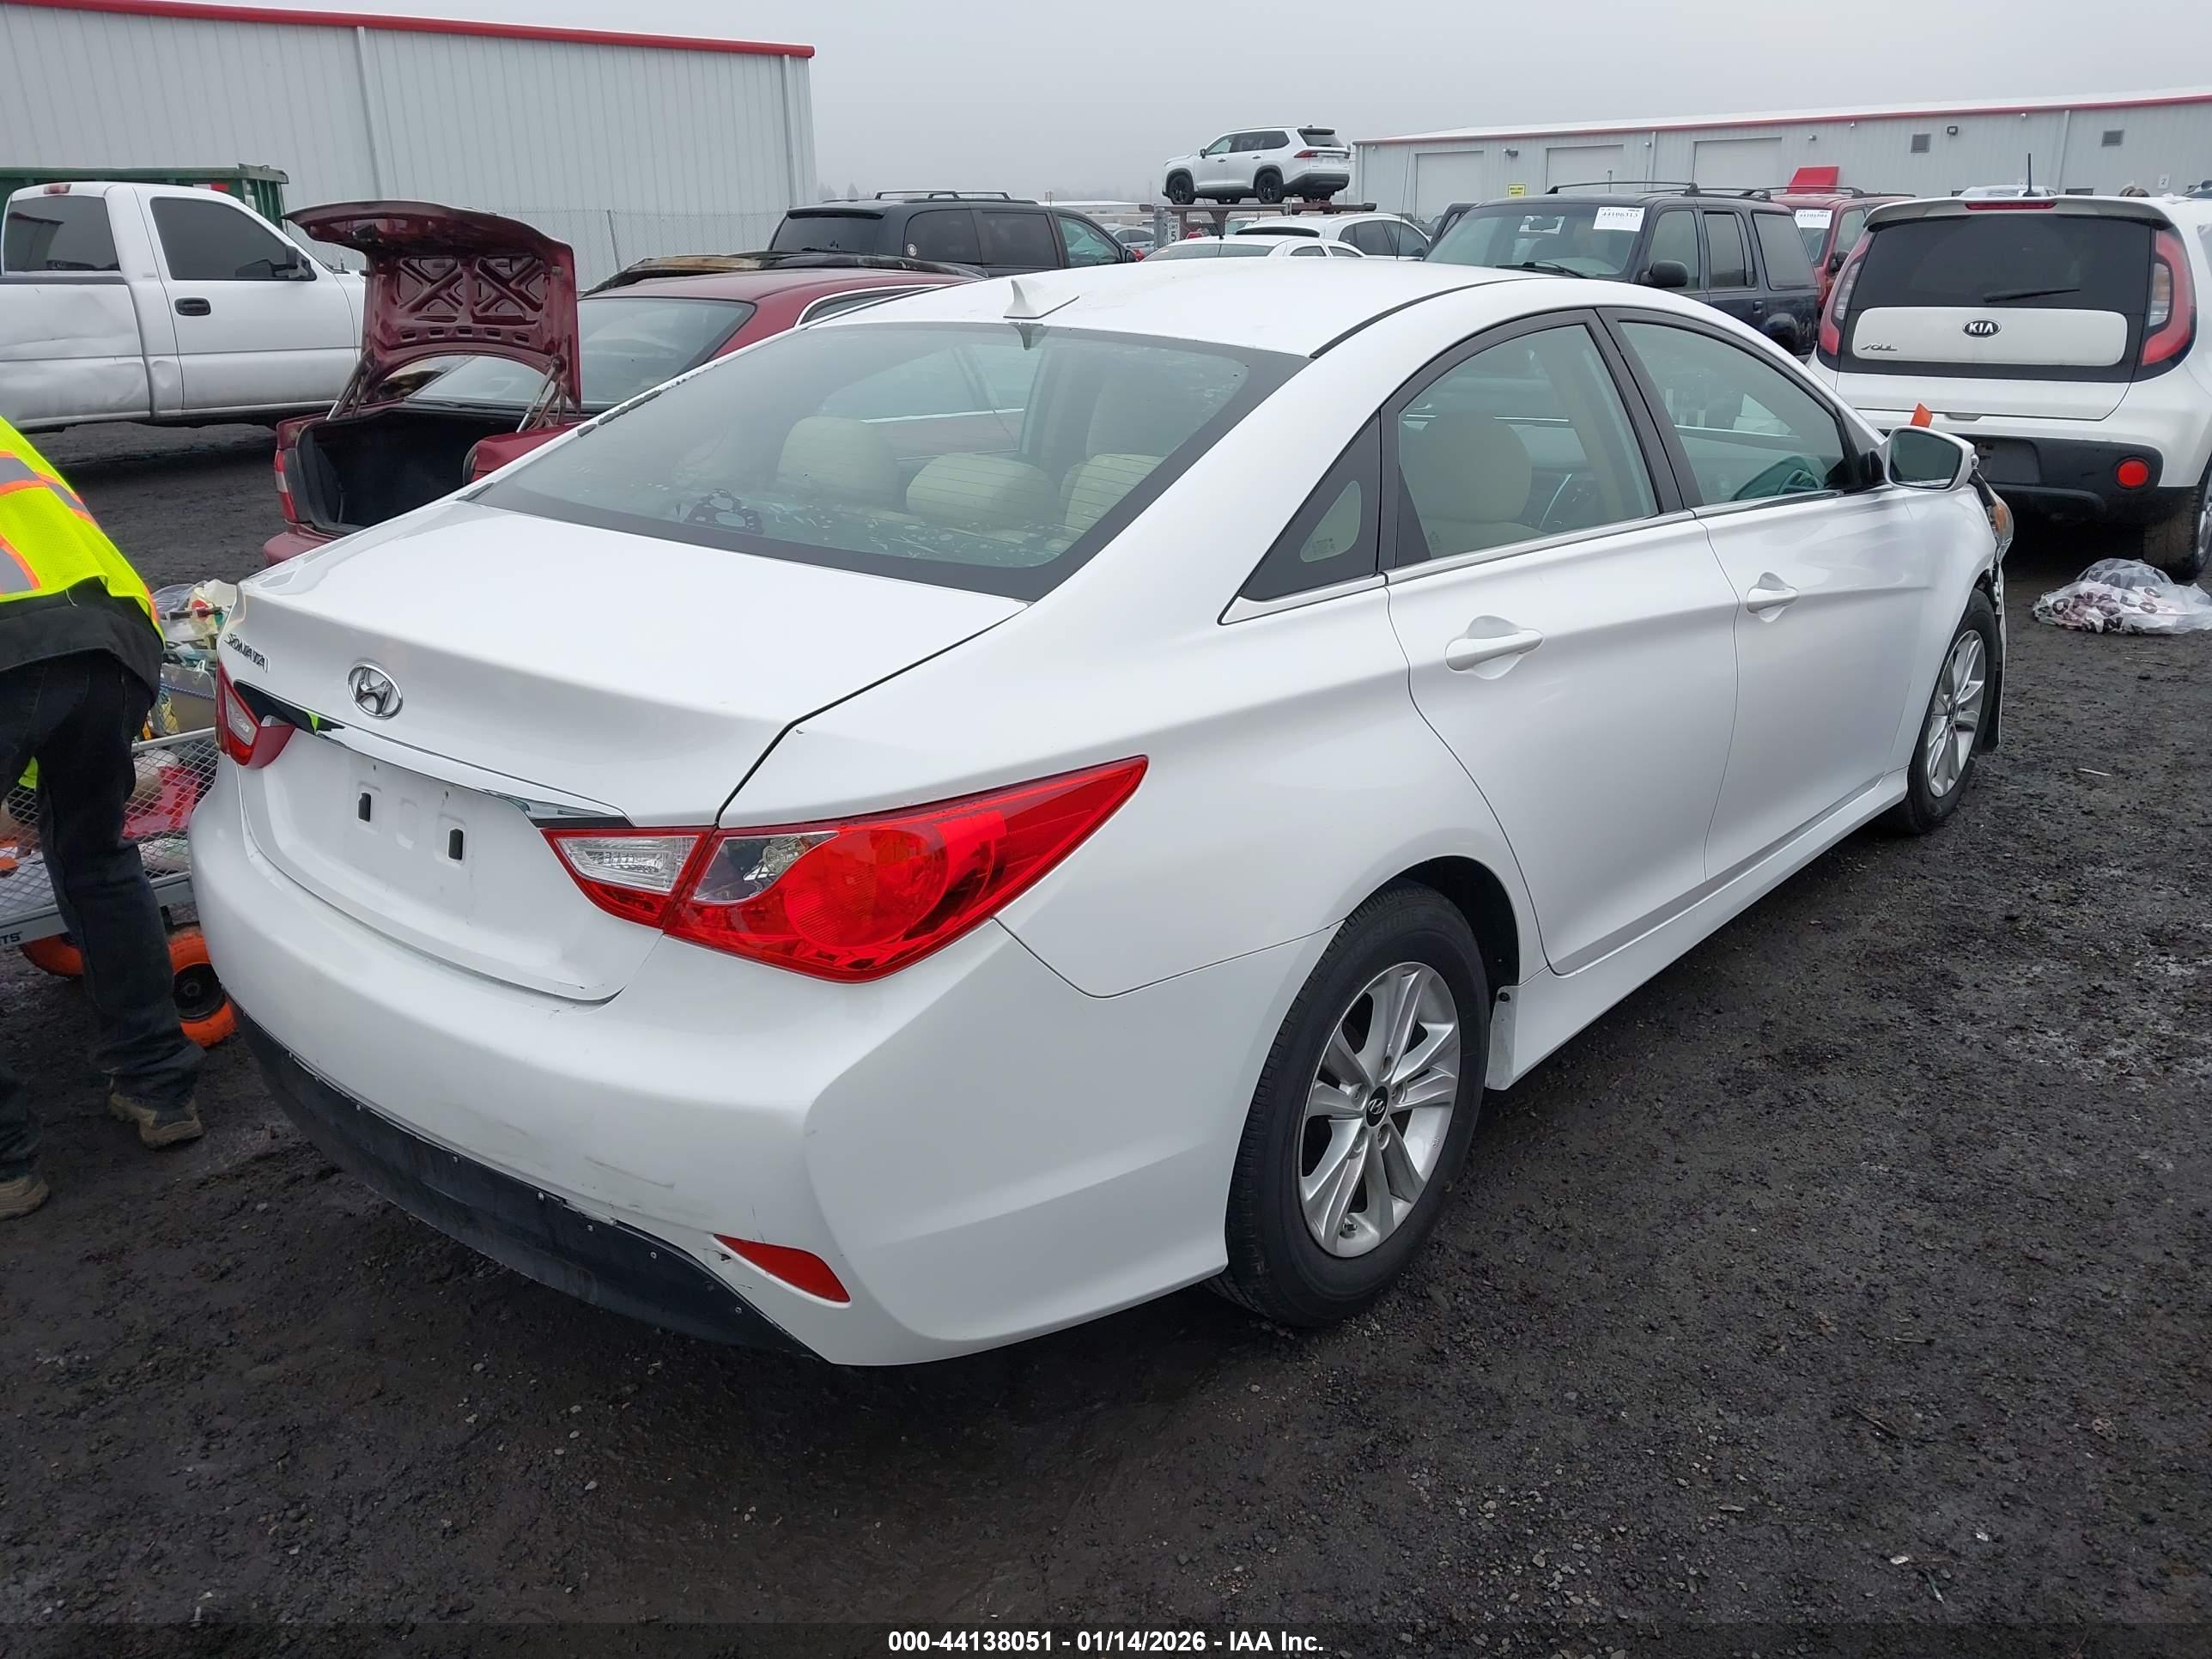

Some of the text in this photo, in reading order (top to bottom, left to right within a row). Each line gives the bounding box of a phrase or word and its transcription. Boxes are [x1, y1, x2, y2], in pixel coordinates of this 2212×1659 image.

[1170, 231, 1176, 242] 5
[1968, 322, 1994, 334] KIA
[223, 633, 269, 674] SONATA
